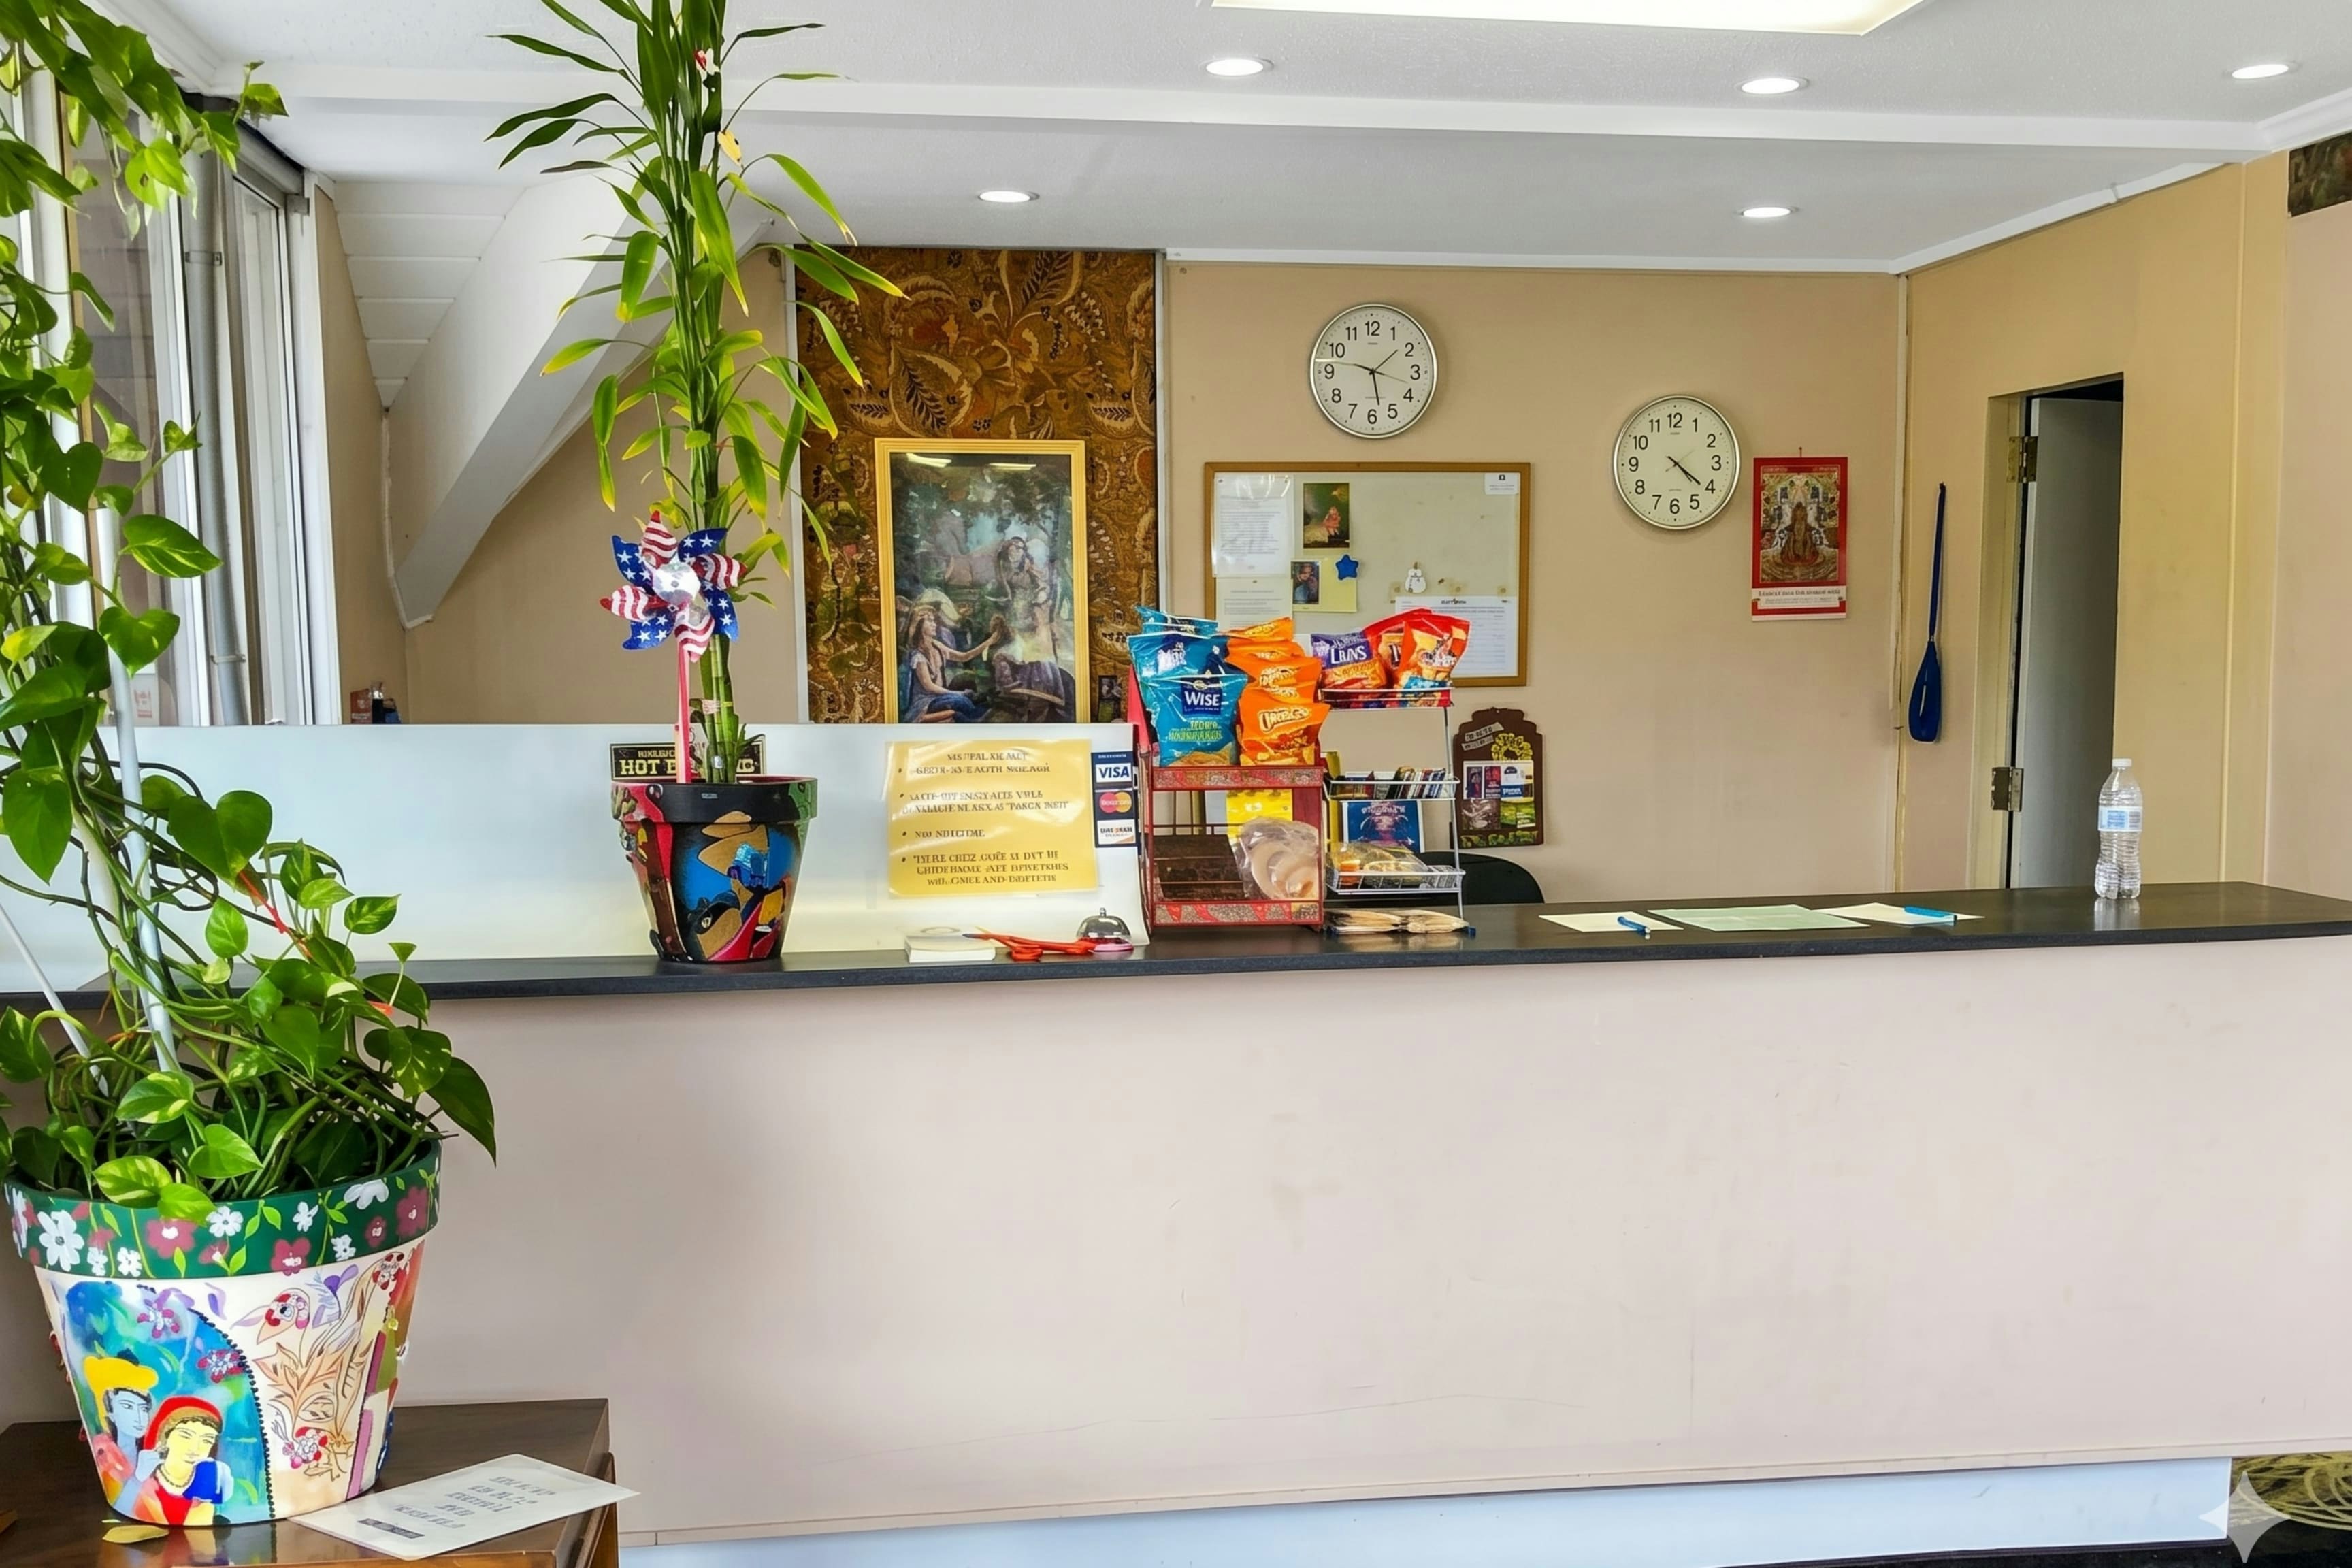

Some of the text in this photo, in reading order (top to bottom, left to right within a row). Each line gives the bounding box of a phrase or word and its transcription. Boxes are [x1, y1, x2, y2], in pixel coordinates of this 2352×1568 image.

[1345, 326, 1357, 341] 11
[1365, 321, 1381, 336] 12
[1390, 326, 1396, 341] 1
[1328, 342, 1345, 358] 10
[1404, 342, 1414, 357] 2
[1324, 363, 1335, 380] 9
[1410, 364, 1421, 380] 3
[1331, 388, 1341, 403] 8
[1403, 388, 1414, 402] 4
[1348, 404, 1358, 419] 7
[1367, 409, 1377, 425] 6
[1387, 404, 1398, 419] 5
[1648, 419, 1661, 433] 11
[1667, 412, 1682, 429] 12
[1692, 417, 1698, 433] 1
[1633, 435, 1648, 450] 10
[1706, 434, 1716, 448] 2
[1628, 456, 1639, 472] 9
[1711, 455, 1722, 471] 3
[1635, 479, 1645, 495] 8
[1705, 479, 1716, 494] 4
[1652, 495, 1662, 510] 7
[1669, 498, 1680, 514] 6
[1689, 494, 1700, 510] 5
[1184, 691, 1220, 706] WISE
[619, 759, 660, 774] HOT
[1098, 766, 1130, 779] VISA
